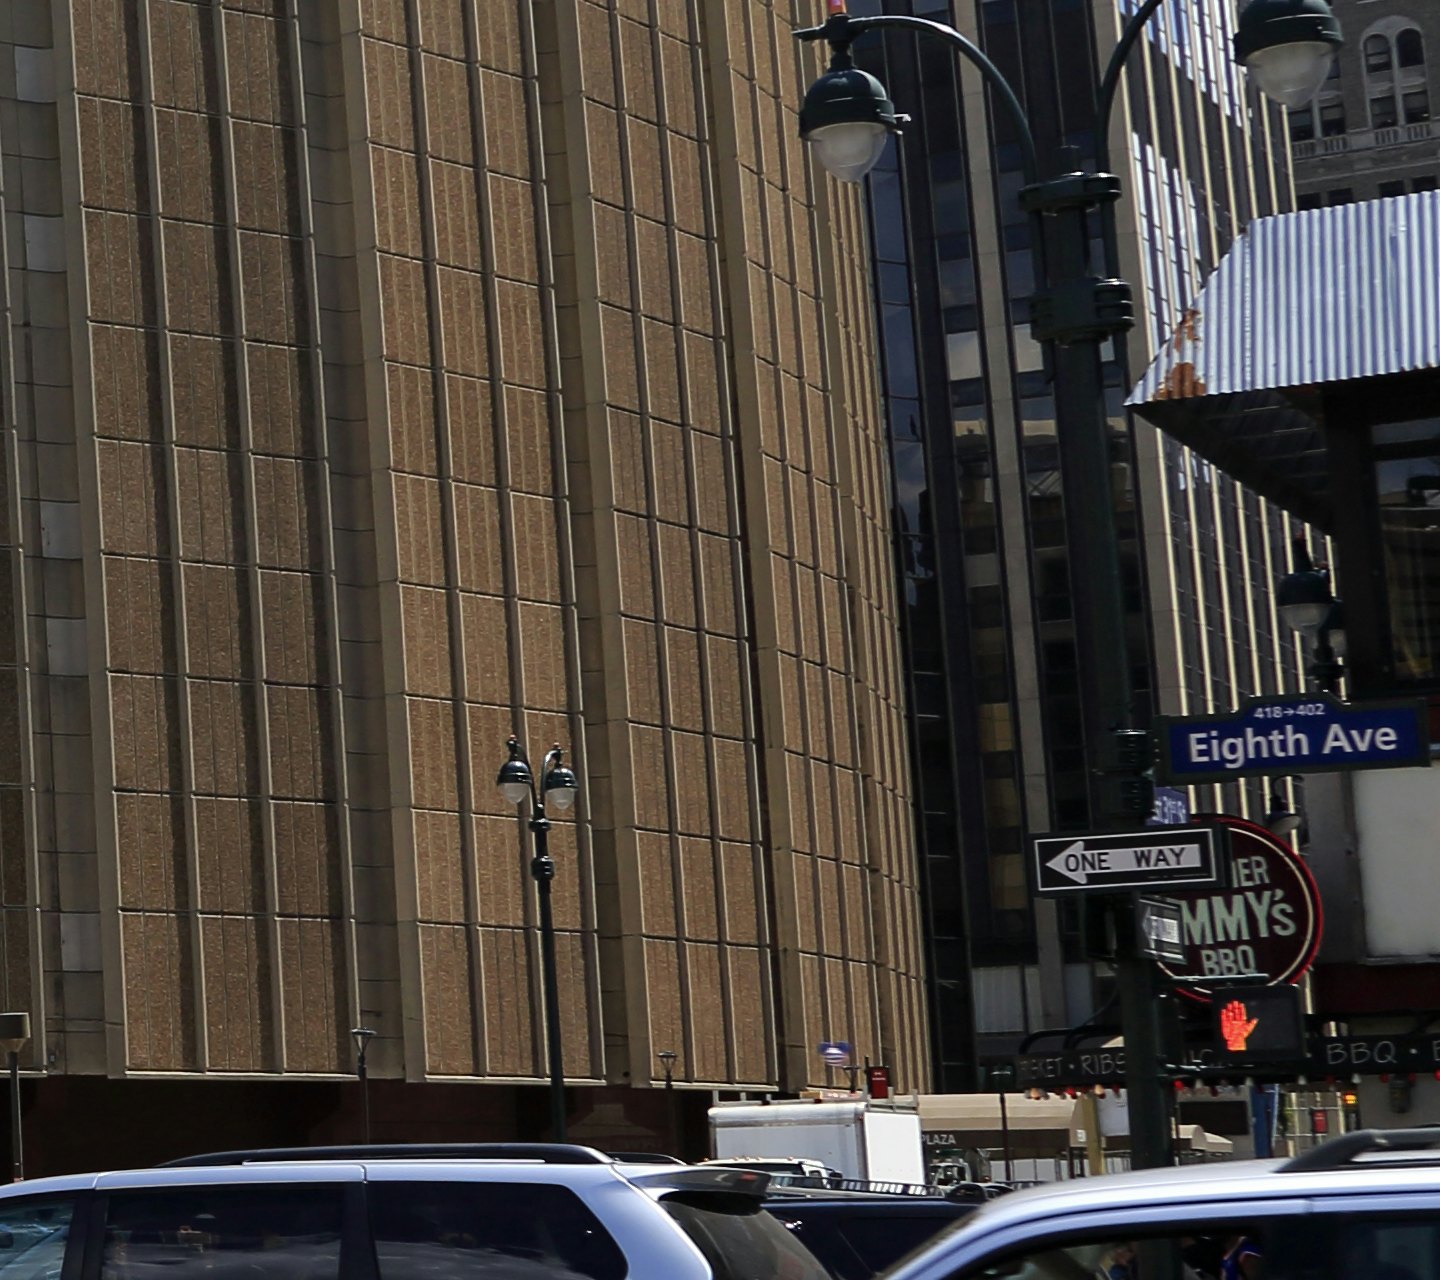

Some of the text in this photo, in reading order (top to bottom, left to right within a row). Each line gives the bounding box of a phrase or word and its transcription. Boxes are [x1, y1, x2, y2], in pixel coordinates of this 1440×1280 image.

[1254, 703, 1326, 719] 418 402
[1188, 723, 1398, 769] Eighth Ave
[1064, 847, 1187, 874] ONE WAY
[1201, 946, 1256, 977] BBQ
[1327, 1041, 1398, 1066] BBQ
